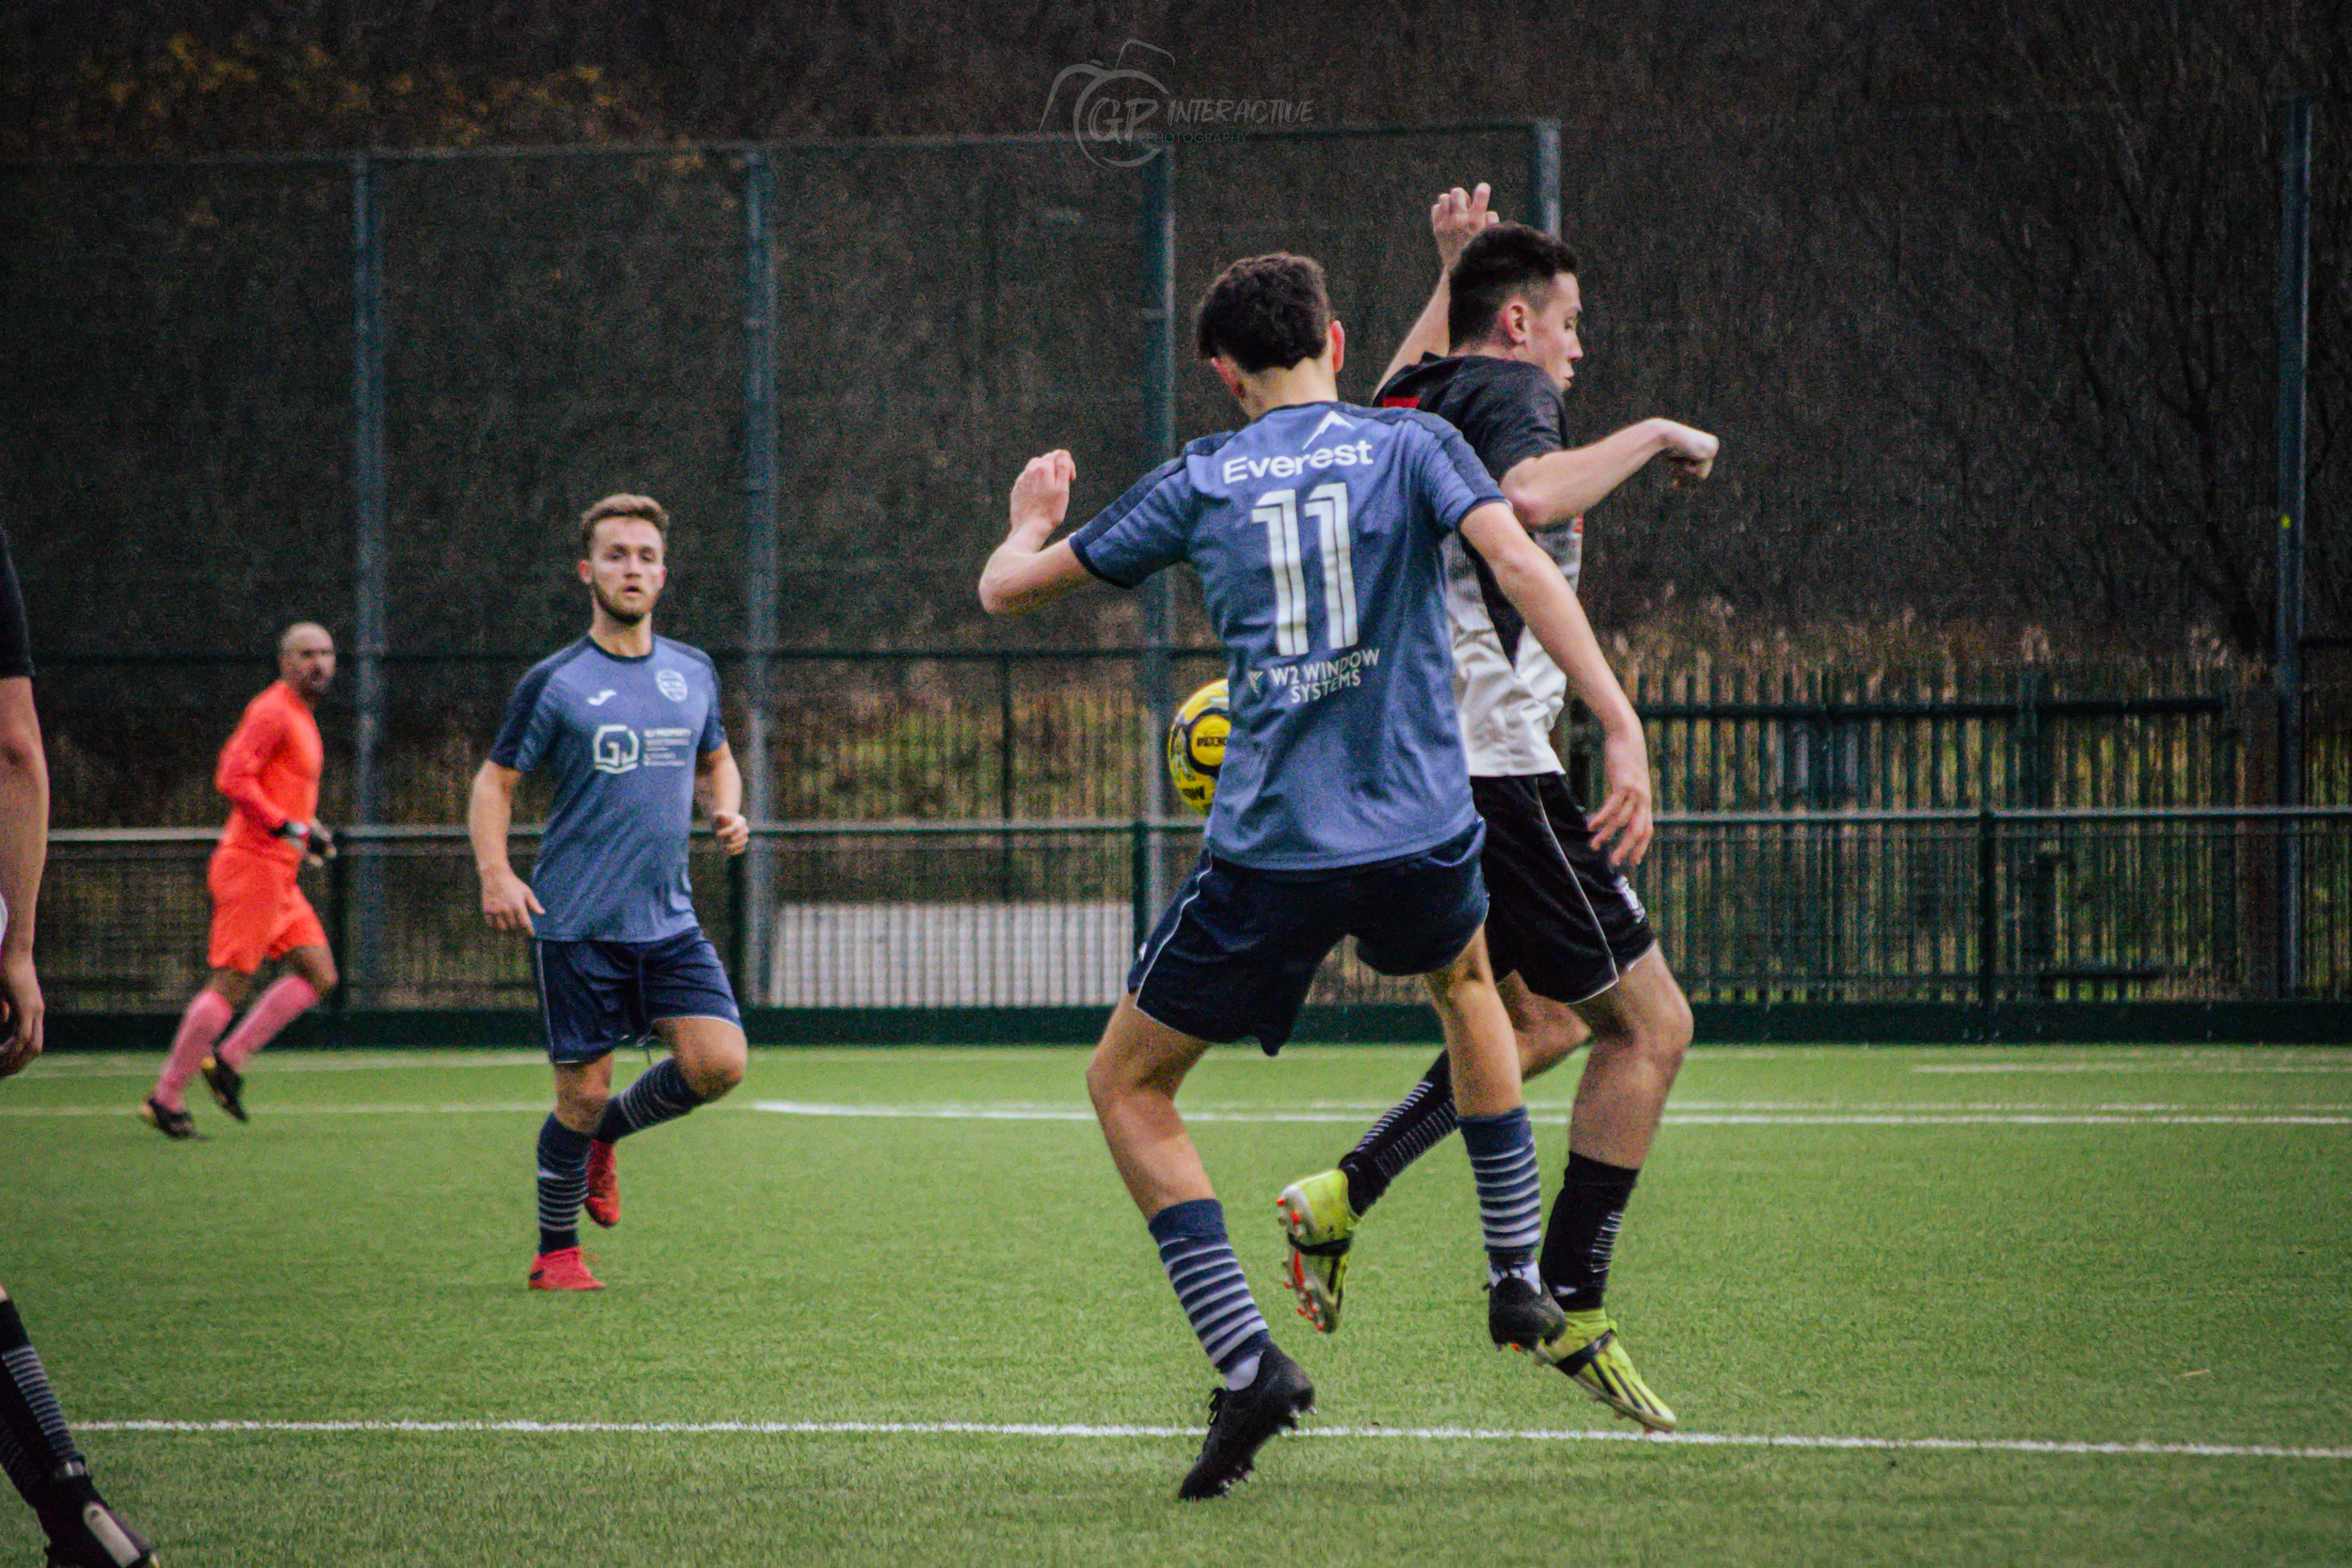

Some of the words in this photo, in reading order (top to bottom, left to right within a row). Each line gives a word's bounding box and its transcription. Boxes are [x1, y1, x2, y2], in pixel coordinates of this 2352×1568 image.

[1224, 439, 1374, 484] Everest
[1252, 482, 1359, 657] 11
[1270, 665, 1300, 687] W2
[1303, 648, 1380, 682] WINDOW
[1291, 669, 1361, 704] SYSTEMS
